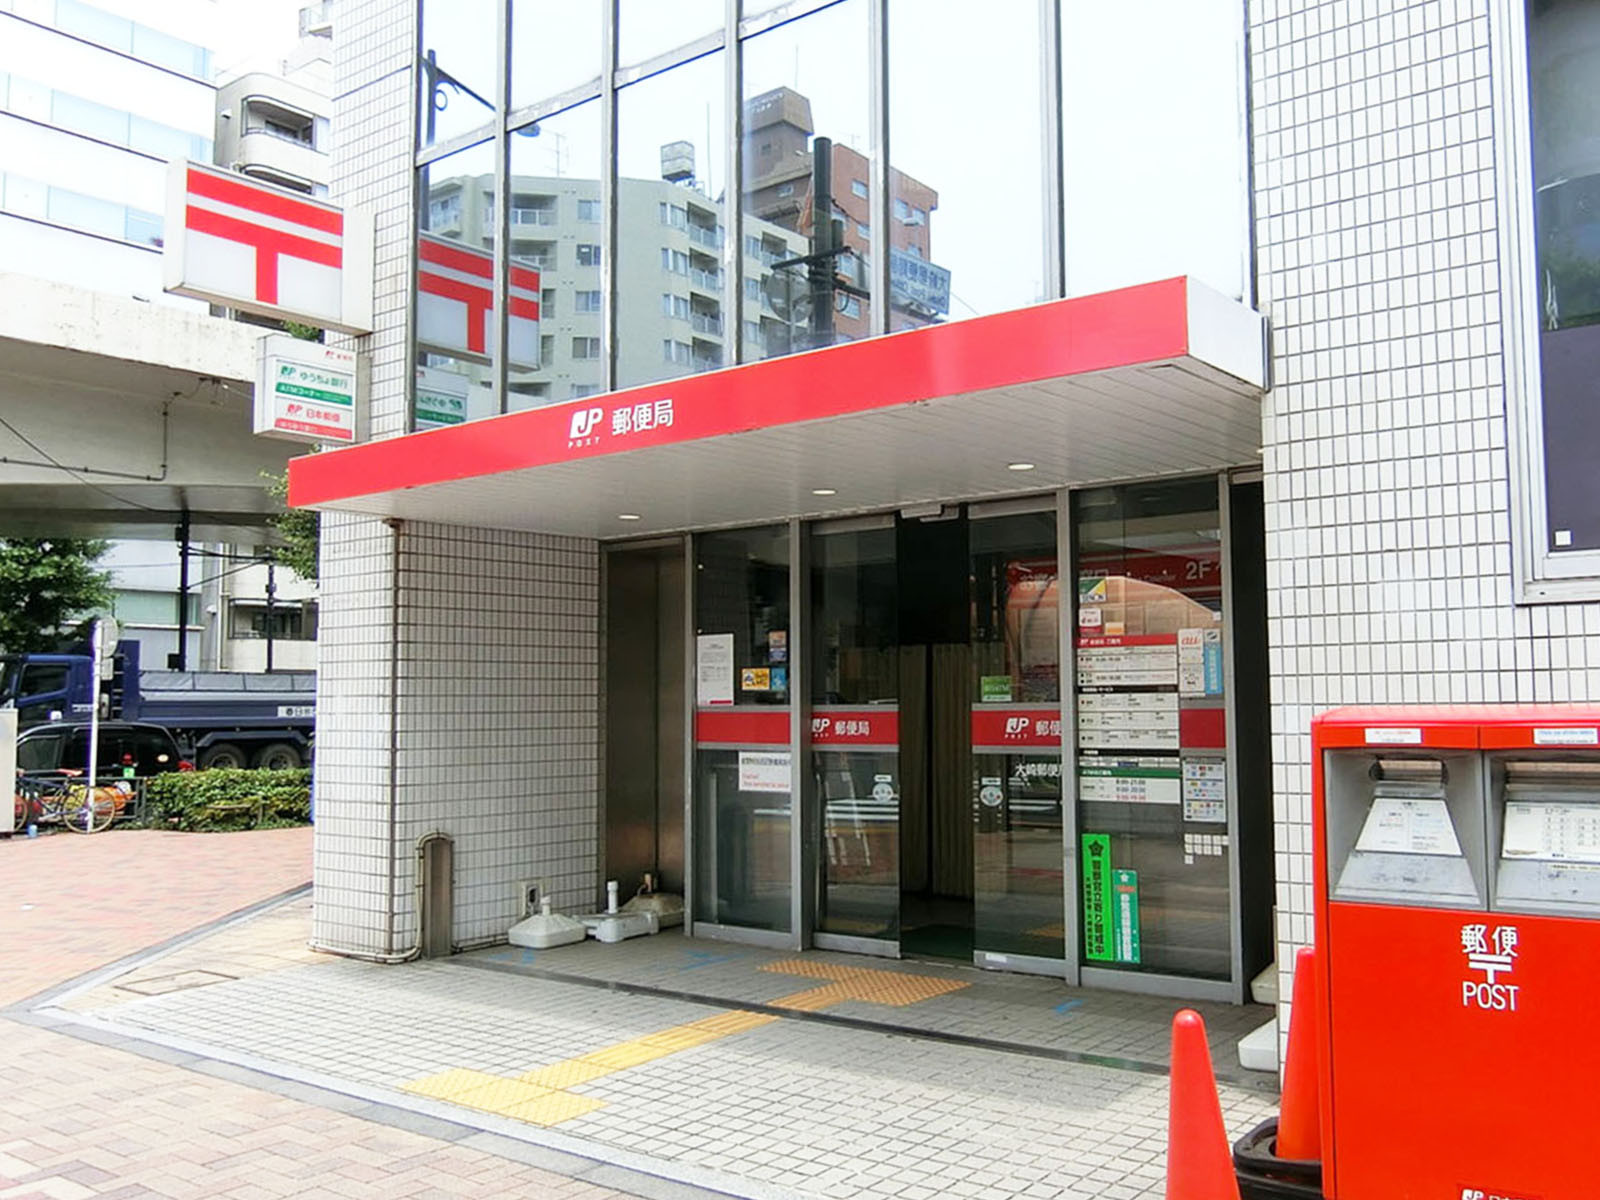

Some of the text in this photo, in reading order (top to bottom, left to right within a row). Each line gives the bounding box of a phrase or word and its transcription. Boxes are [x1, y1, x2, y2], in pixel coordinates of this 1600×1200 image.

[612, 399, 674, 436] 郵便局
[568, 437, 601, 448] POST
[1185, 560, 1211, 580] 2F
[834, 720, 871, 736] 郵便局
[1460, 924, 1519, 957] 郵便
[1462, 981, 1519, 1011] POST
